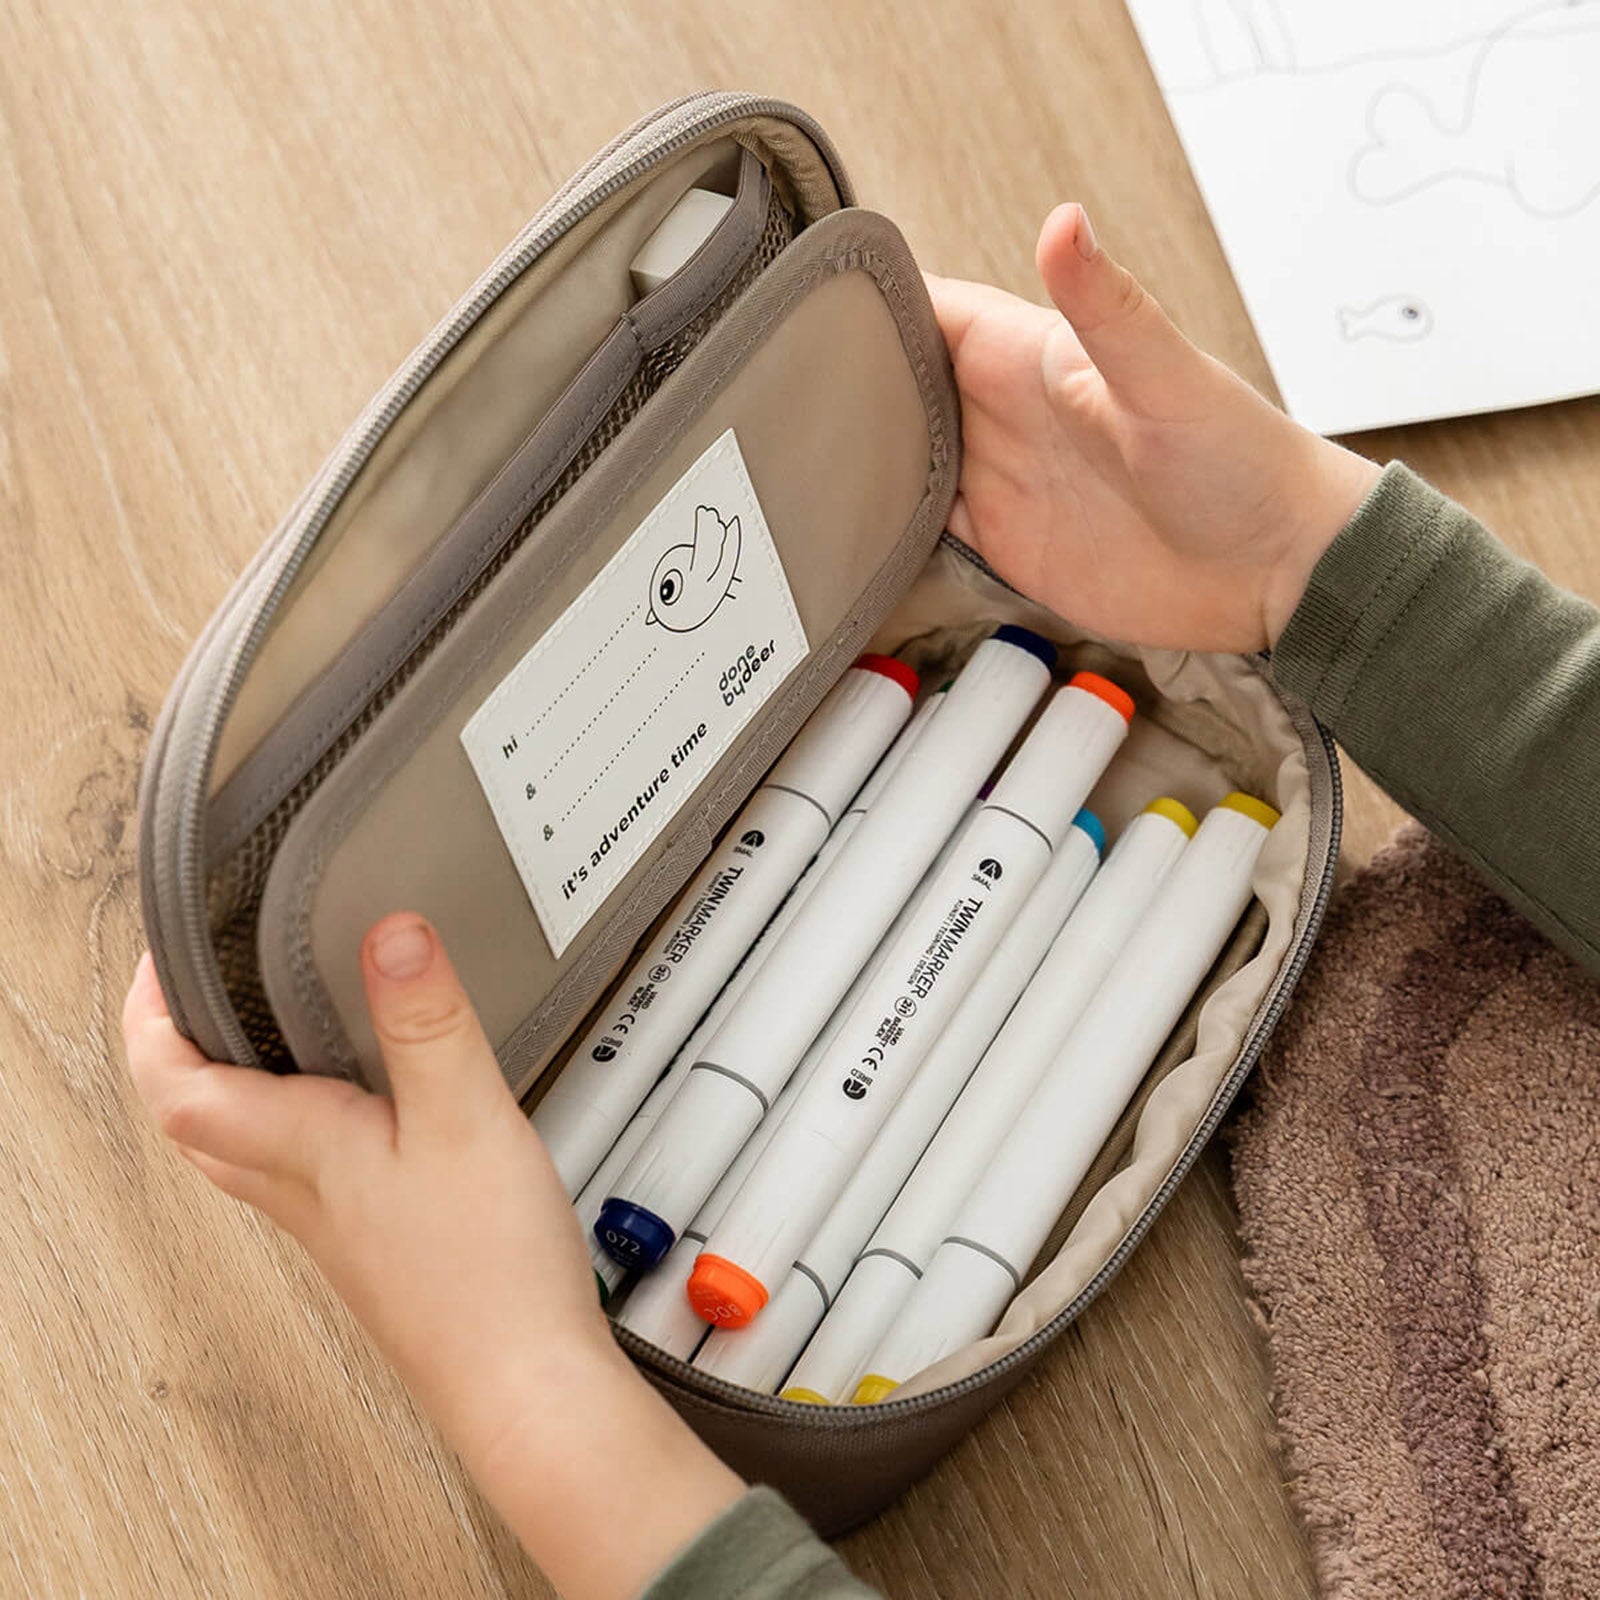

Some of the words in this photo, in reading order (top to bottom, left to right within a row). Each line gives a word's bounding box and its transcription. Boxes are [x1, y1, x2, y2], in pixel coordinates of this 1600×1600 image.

[502, 735, 518, 759] hi
[561, 865, 589, 901] it's
[590, 768, 671, 868] adventure
[670, 722, 708, 769] time
[606, 1229, 641, 1256] 072
